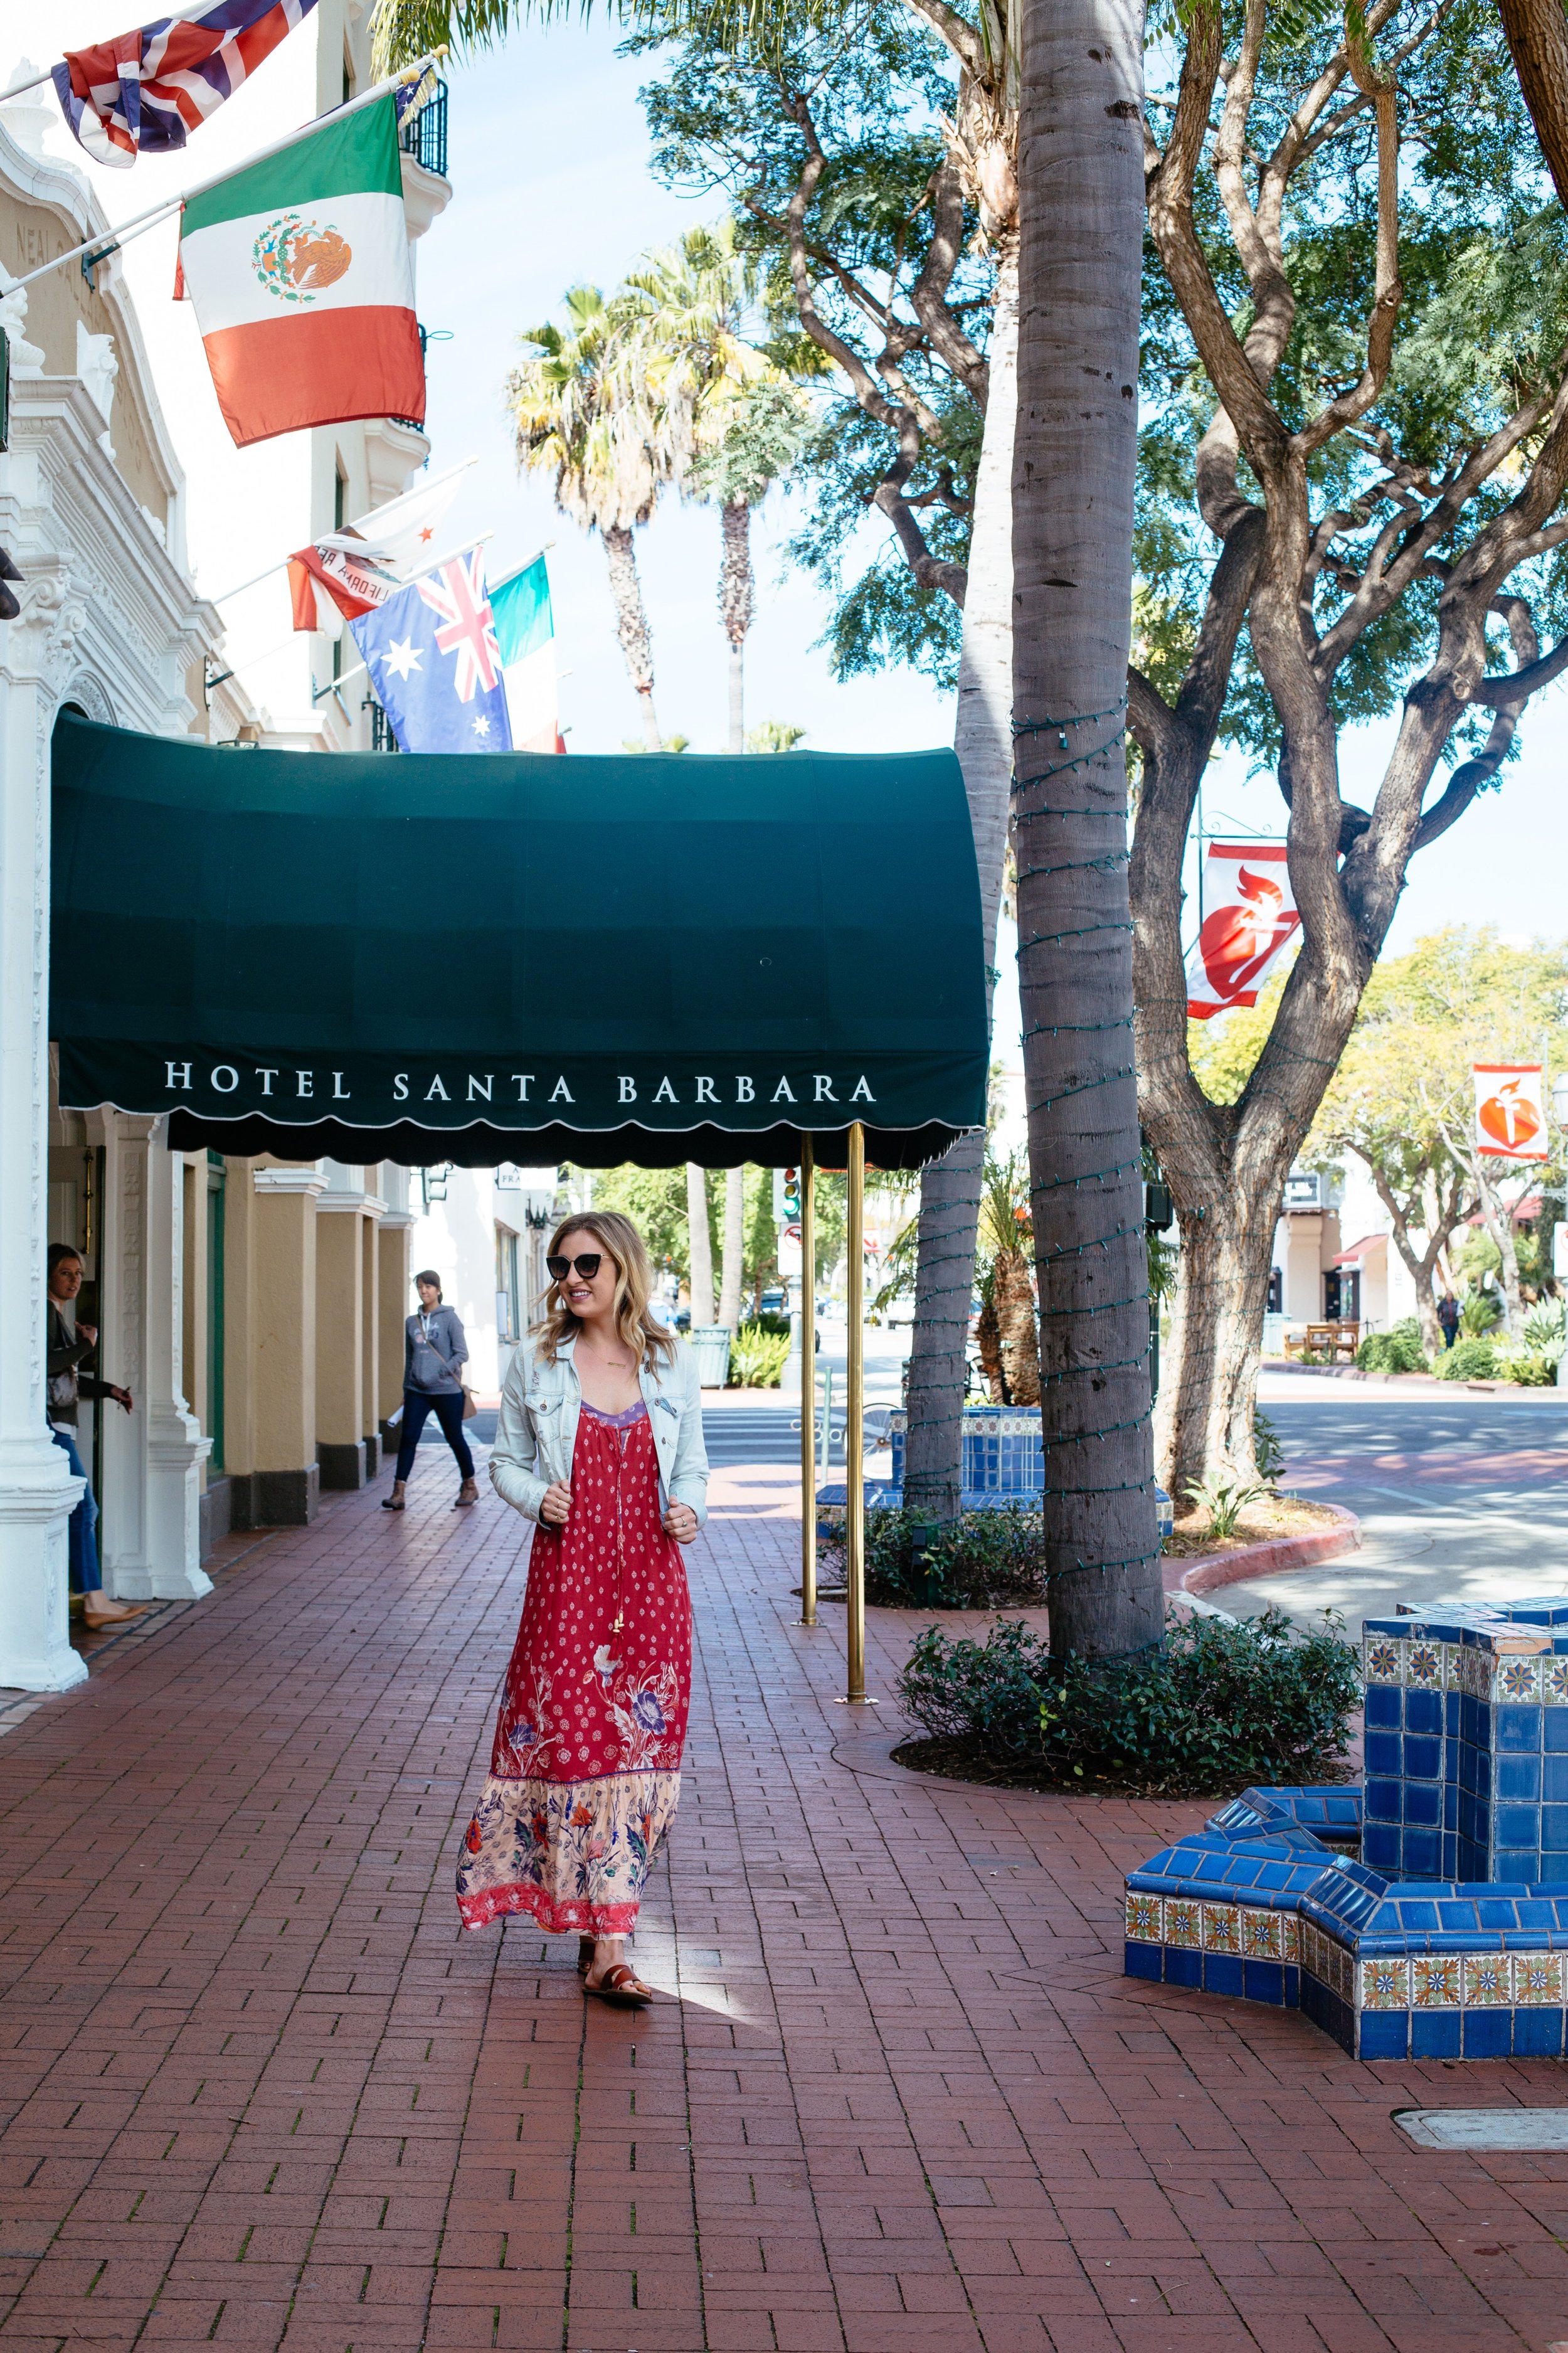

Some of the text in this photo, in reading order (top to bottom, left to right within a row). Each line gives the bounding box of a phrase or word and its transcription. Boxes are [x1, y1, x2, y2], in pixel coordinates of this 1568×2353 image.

[164, 1061, 877, 1103] HOTEL SANTA BARBARA
